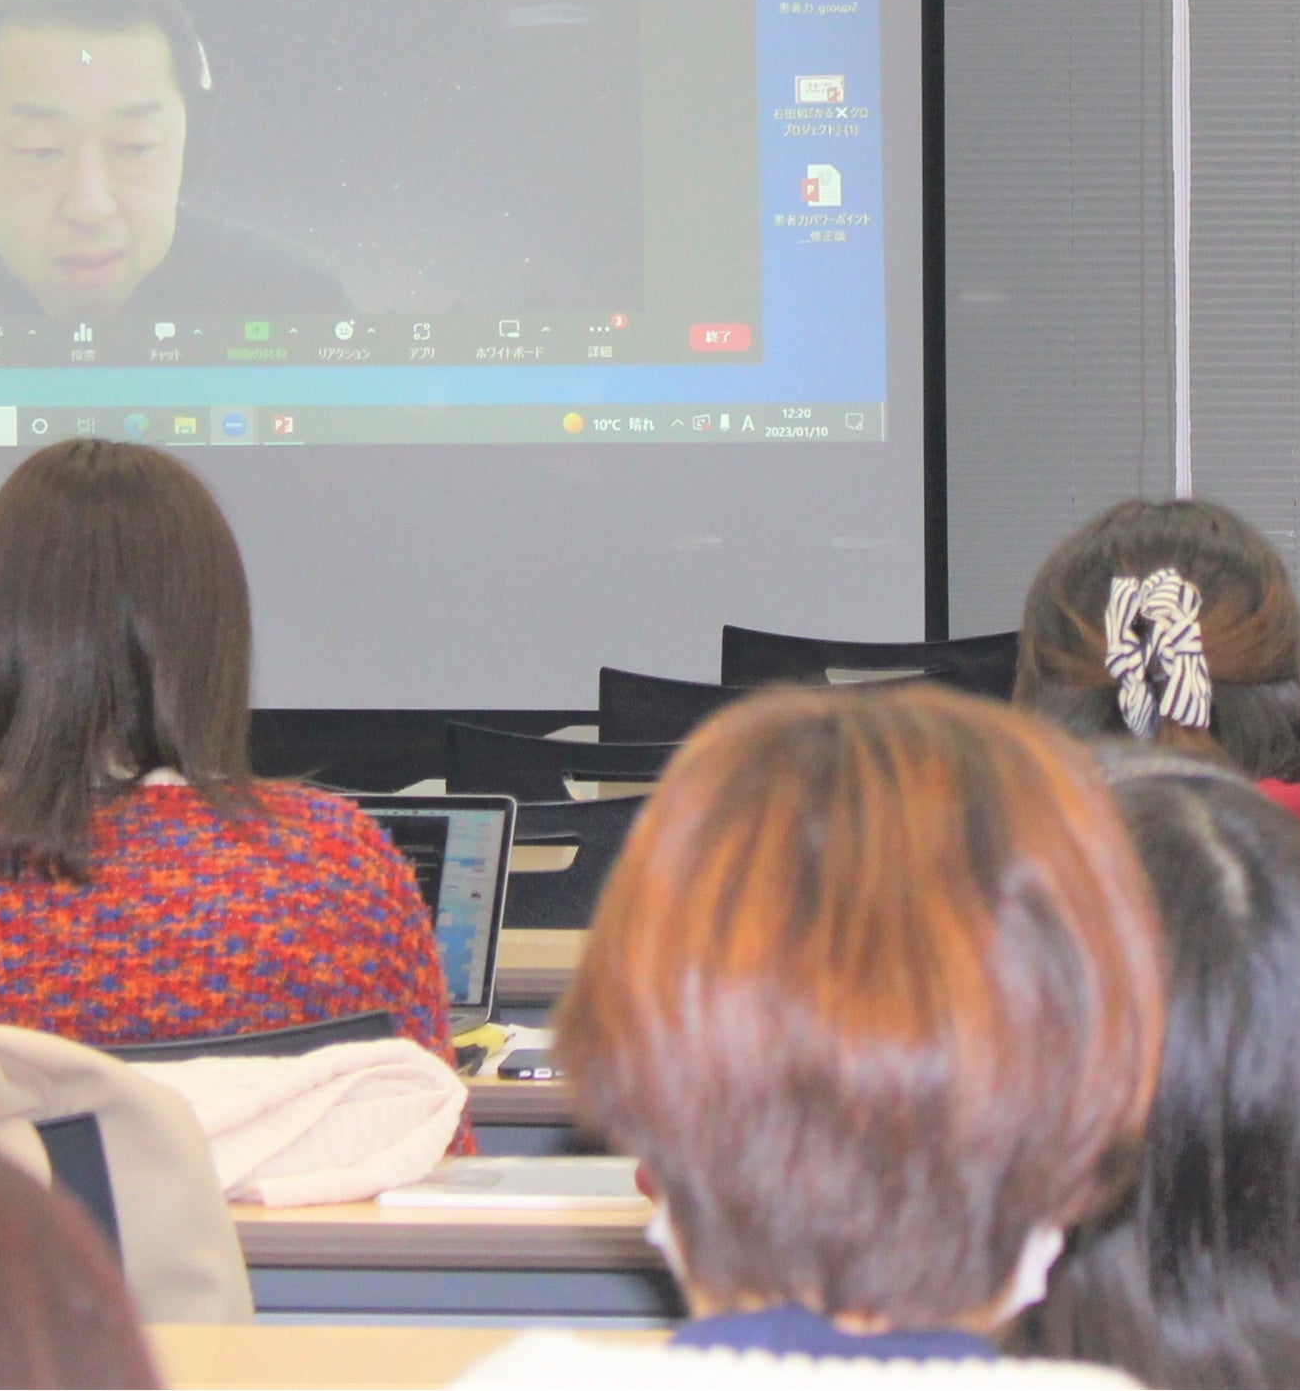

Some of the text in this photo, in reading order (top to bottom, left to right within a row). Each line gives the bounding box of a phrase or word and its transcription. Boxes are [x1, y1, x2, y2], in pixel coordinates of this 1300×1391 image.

[705, 330, 731, 344] 終了
[150, 349, 181, 361] チャット
[318, 347, 370, 360] リアクション
[409, 347, 435, 360] アプリ
[475, 347, 544, 360] ホワイトボード
[588, 346, 613, 359] 詳細
[782, 408, 811, 419] 12:20
[629, 417, 655, 432] 晴れ
[742, 415, 755, 431] A
[765, 425, 828, 438] 2023/01/10
